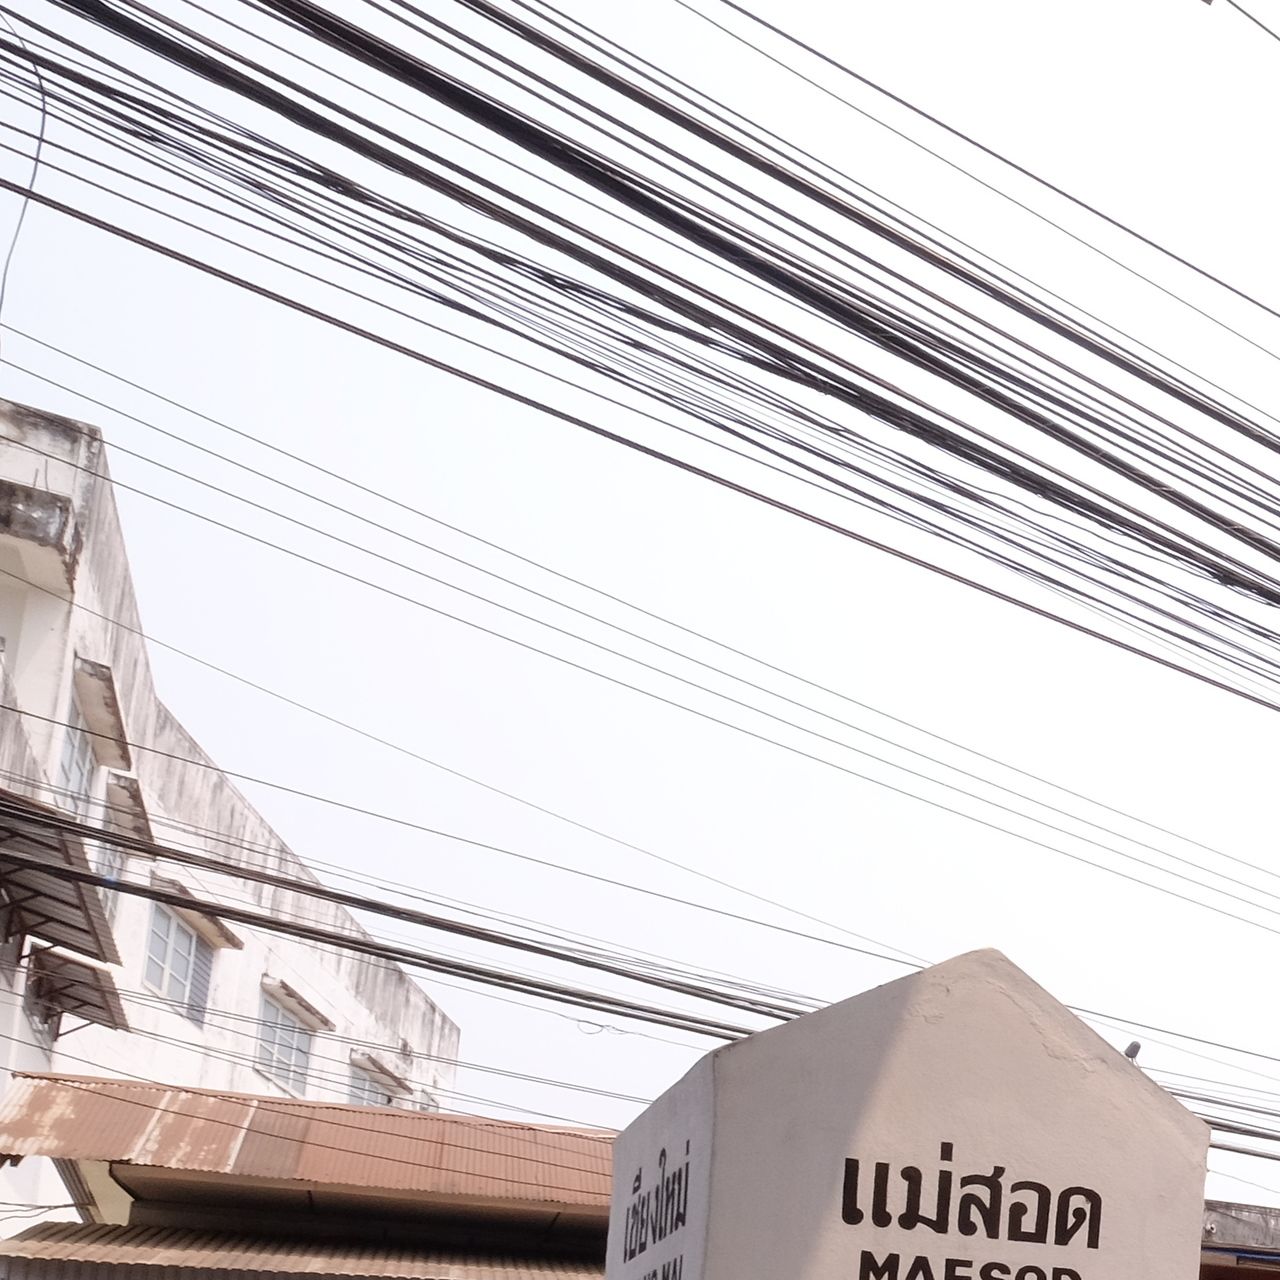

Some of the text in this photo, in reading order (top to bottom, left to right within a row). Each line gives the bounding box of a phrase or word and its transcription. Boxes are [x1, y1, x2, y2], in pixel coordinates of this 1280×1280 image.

[622, 1139, 691, 1264] เชียงใหม่
[841, 1141, 1102, 1249] แม่สอด
